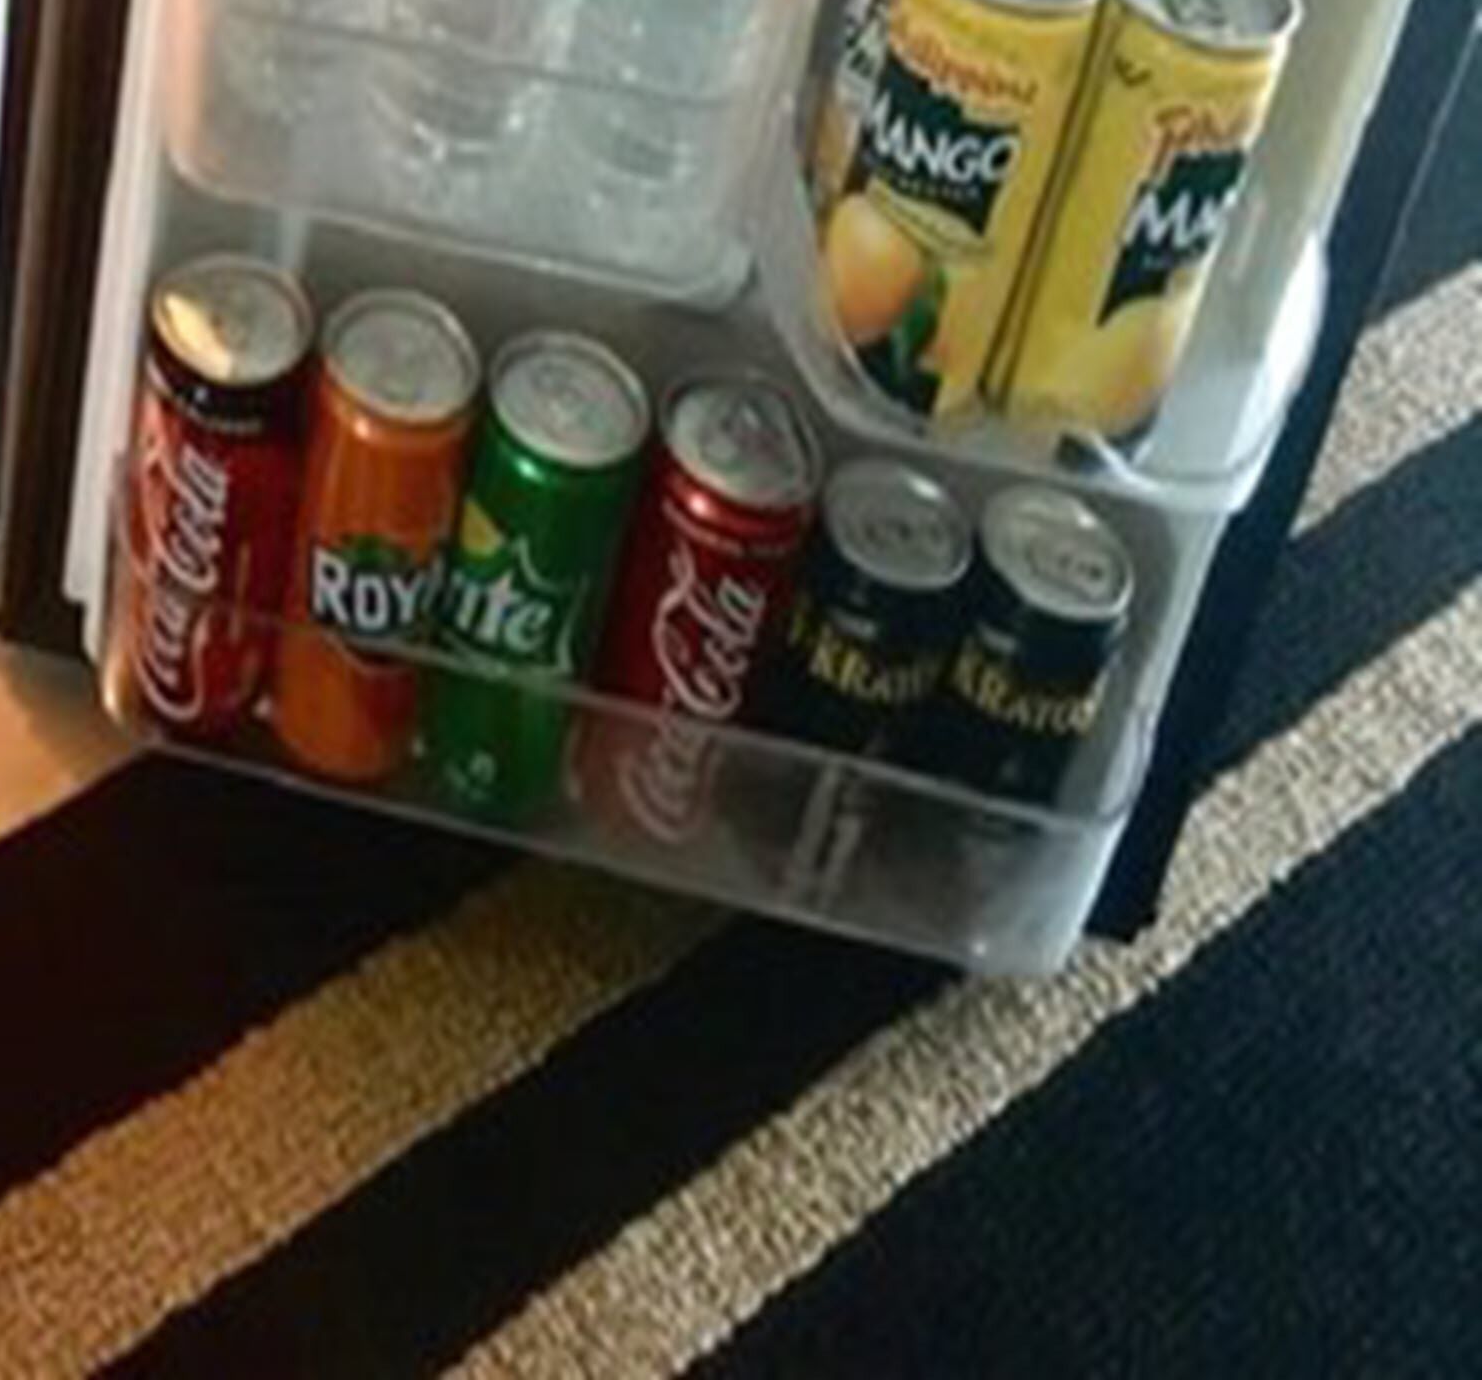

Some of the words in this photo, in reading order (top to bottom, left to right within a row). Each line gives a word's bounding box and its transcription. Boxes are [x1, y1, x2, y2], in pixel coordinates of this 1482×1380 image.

[866, 88, 1021, 182] MANGO
[311, 544, 444, 632] ROY
[452, 566, 553, 653] ite
